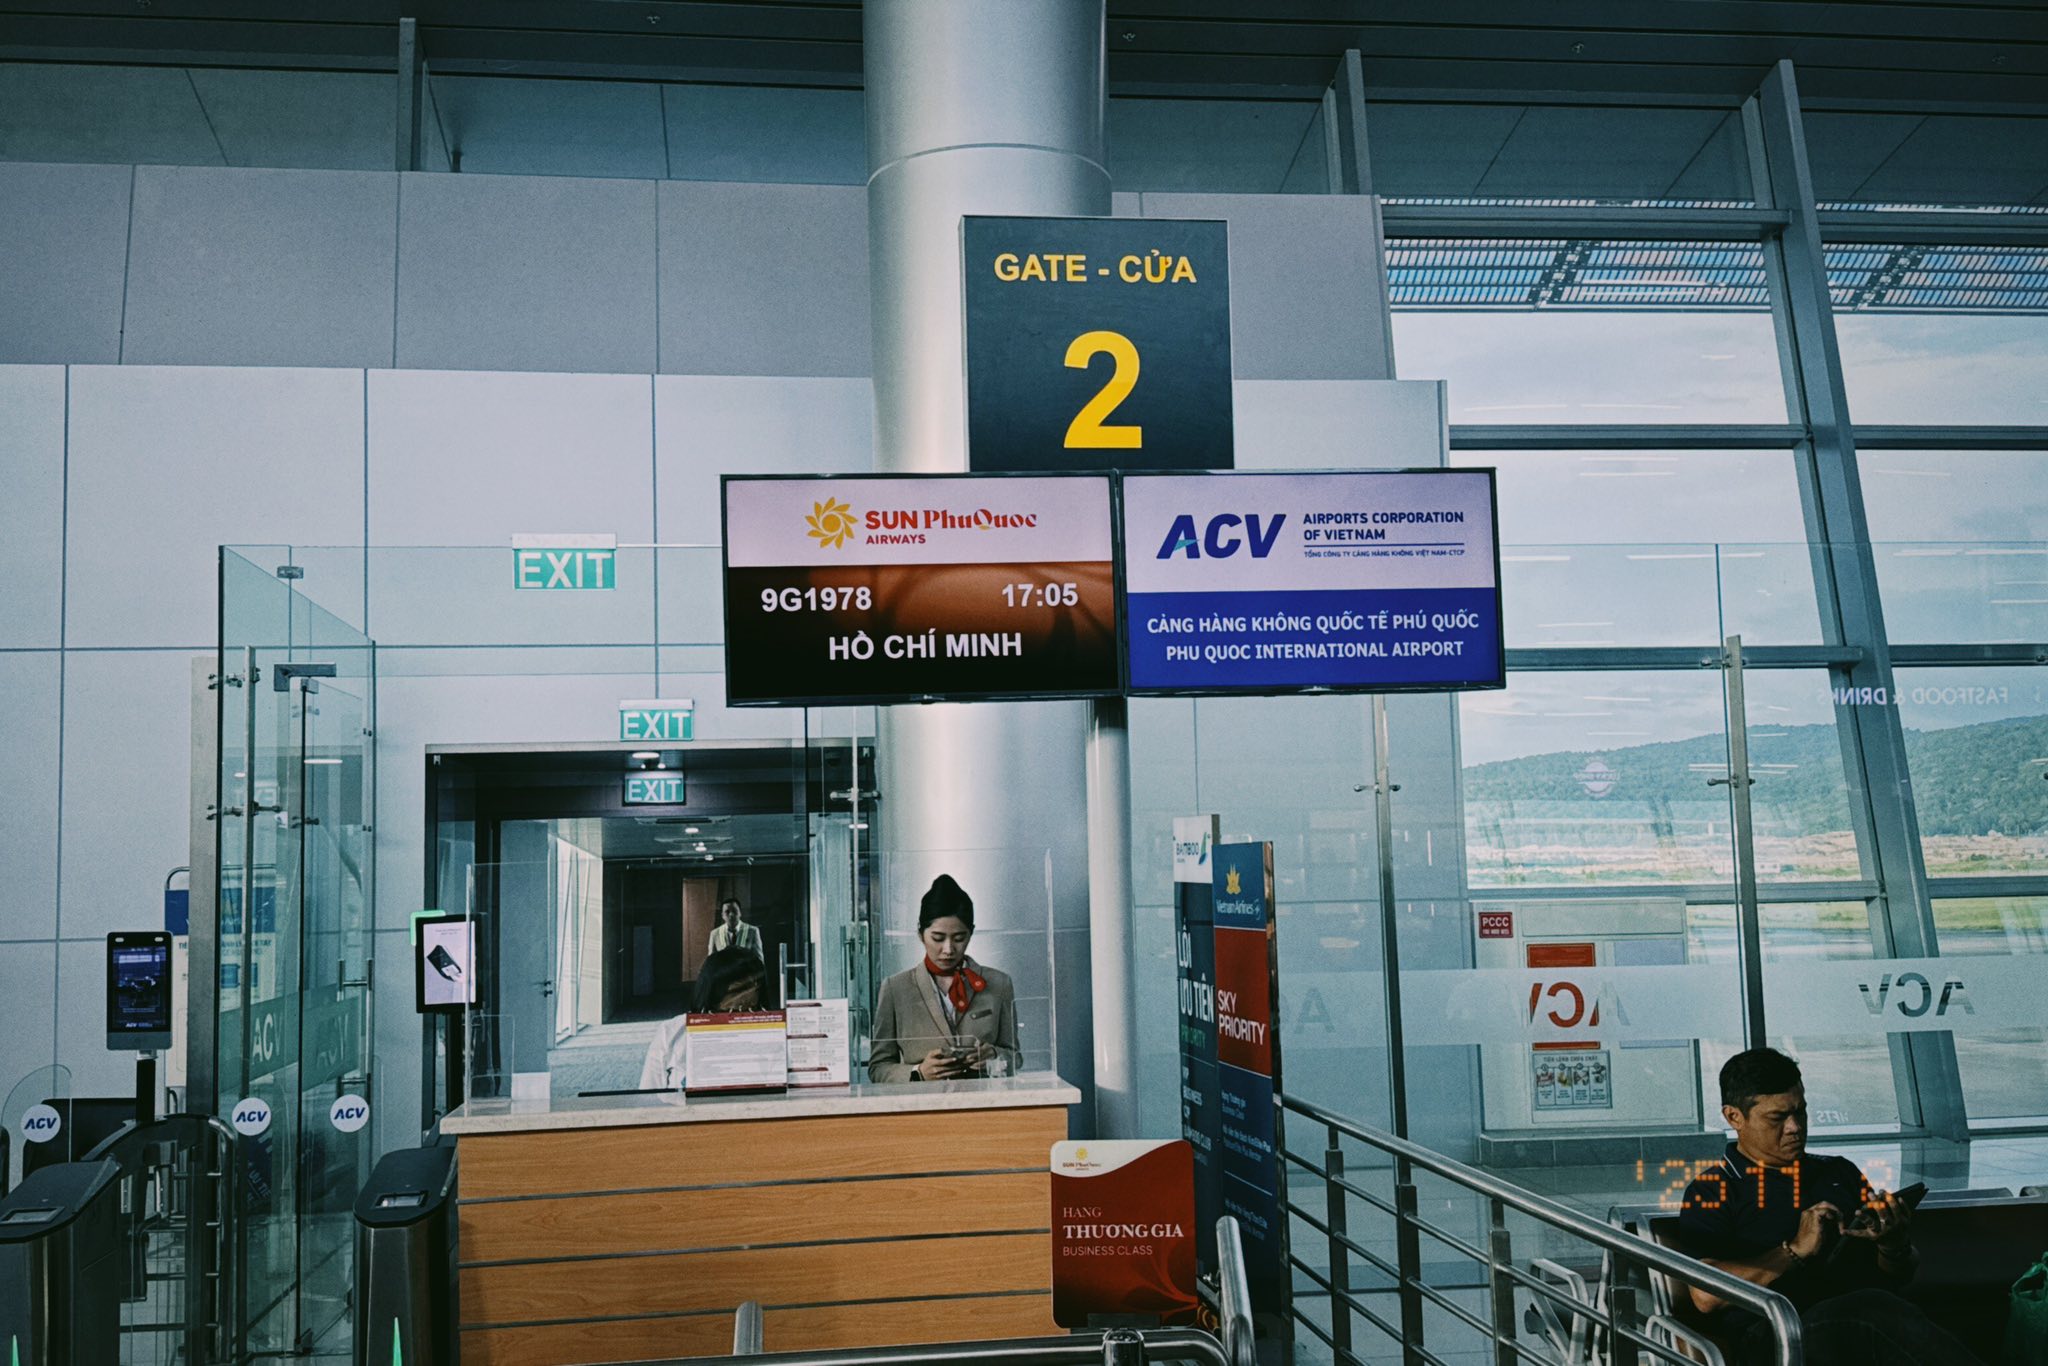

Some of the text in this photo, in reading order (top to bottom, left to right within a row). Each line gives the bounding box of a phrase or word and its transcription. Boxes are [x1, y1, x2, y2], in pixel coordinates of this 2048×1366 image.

[994, 249, 1197, 283] GATE - CỬA
[1063, 330, 1143, 449] 2
[865, 510, 918, 530] SUN
[1303, 511, 1464, 525] AIRPORTS CORPORATION
[866, 534, 926, 545] AIRWAYS
[1156, 513, 1287, 559] ACV
[1304, 528, 1386, 541] OF VIETNAM
[518, 552, 612, 588] EXIT
[761, 583, 1079, 612] 9G1978 17:05
[1147, 608, 1479, 634] CẢNG HÀNG KHÔNG QUỐC TẾ PHÚ QUỐC
[829, 628, 1022, 660] HỒ CHÍ MINH
[1166, 641, 1464, 664] PHU QUOC INTERNATIONAL AIRPORT
[623, 712, 690, 739] EXIT
[628, 779, 682, 801] EXIT
[1482, 917, 1510, 928] PCCC
[1218, 989, 1237, 1014] SKY
[1218, 1013, 1267, 1046] PRIORITY
[24, 1118, 57, 1129] ACV
[235, 1111, 268, 1123] ACV
[333, 1107, 366, 1120] ACV
[1151, 1223, 1184, 1238] GIA
[1063, 1245, 1153, 1257] BUSINESS CLASS
